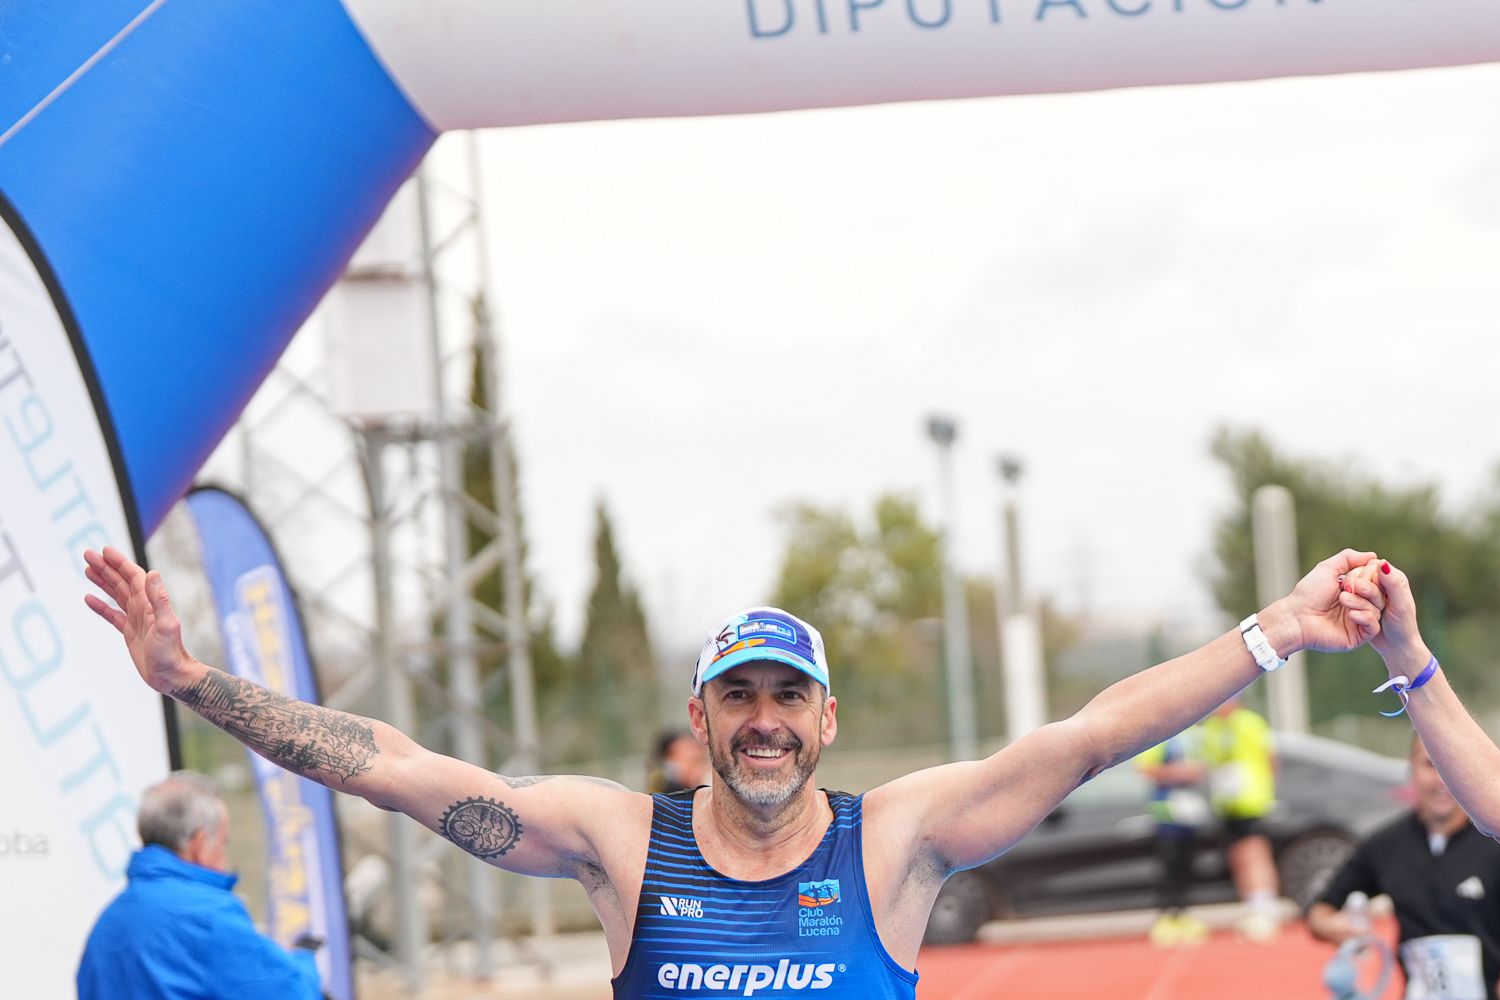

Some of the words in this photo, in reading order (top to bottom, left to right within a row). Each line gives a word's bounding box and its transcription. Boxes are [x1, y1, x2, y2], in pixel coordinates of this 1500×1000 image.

[679, 898, 701, 908] RUN
[680, 907, 704, 918] PRO
[799, 908, 824, 918] Club
[799, 914, 843, 927] Maratón
[799, 926, 840, 937] Lucena
